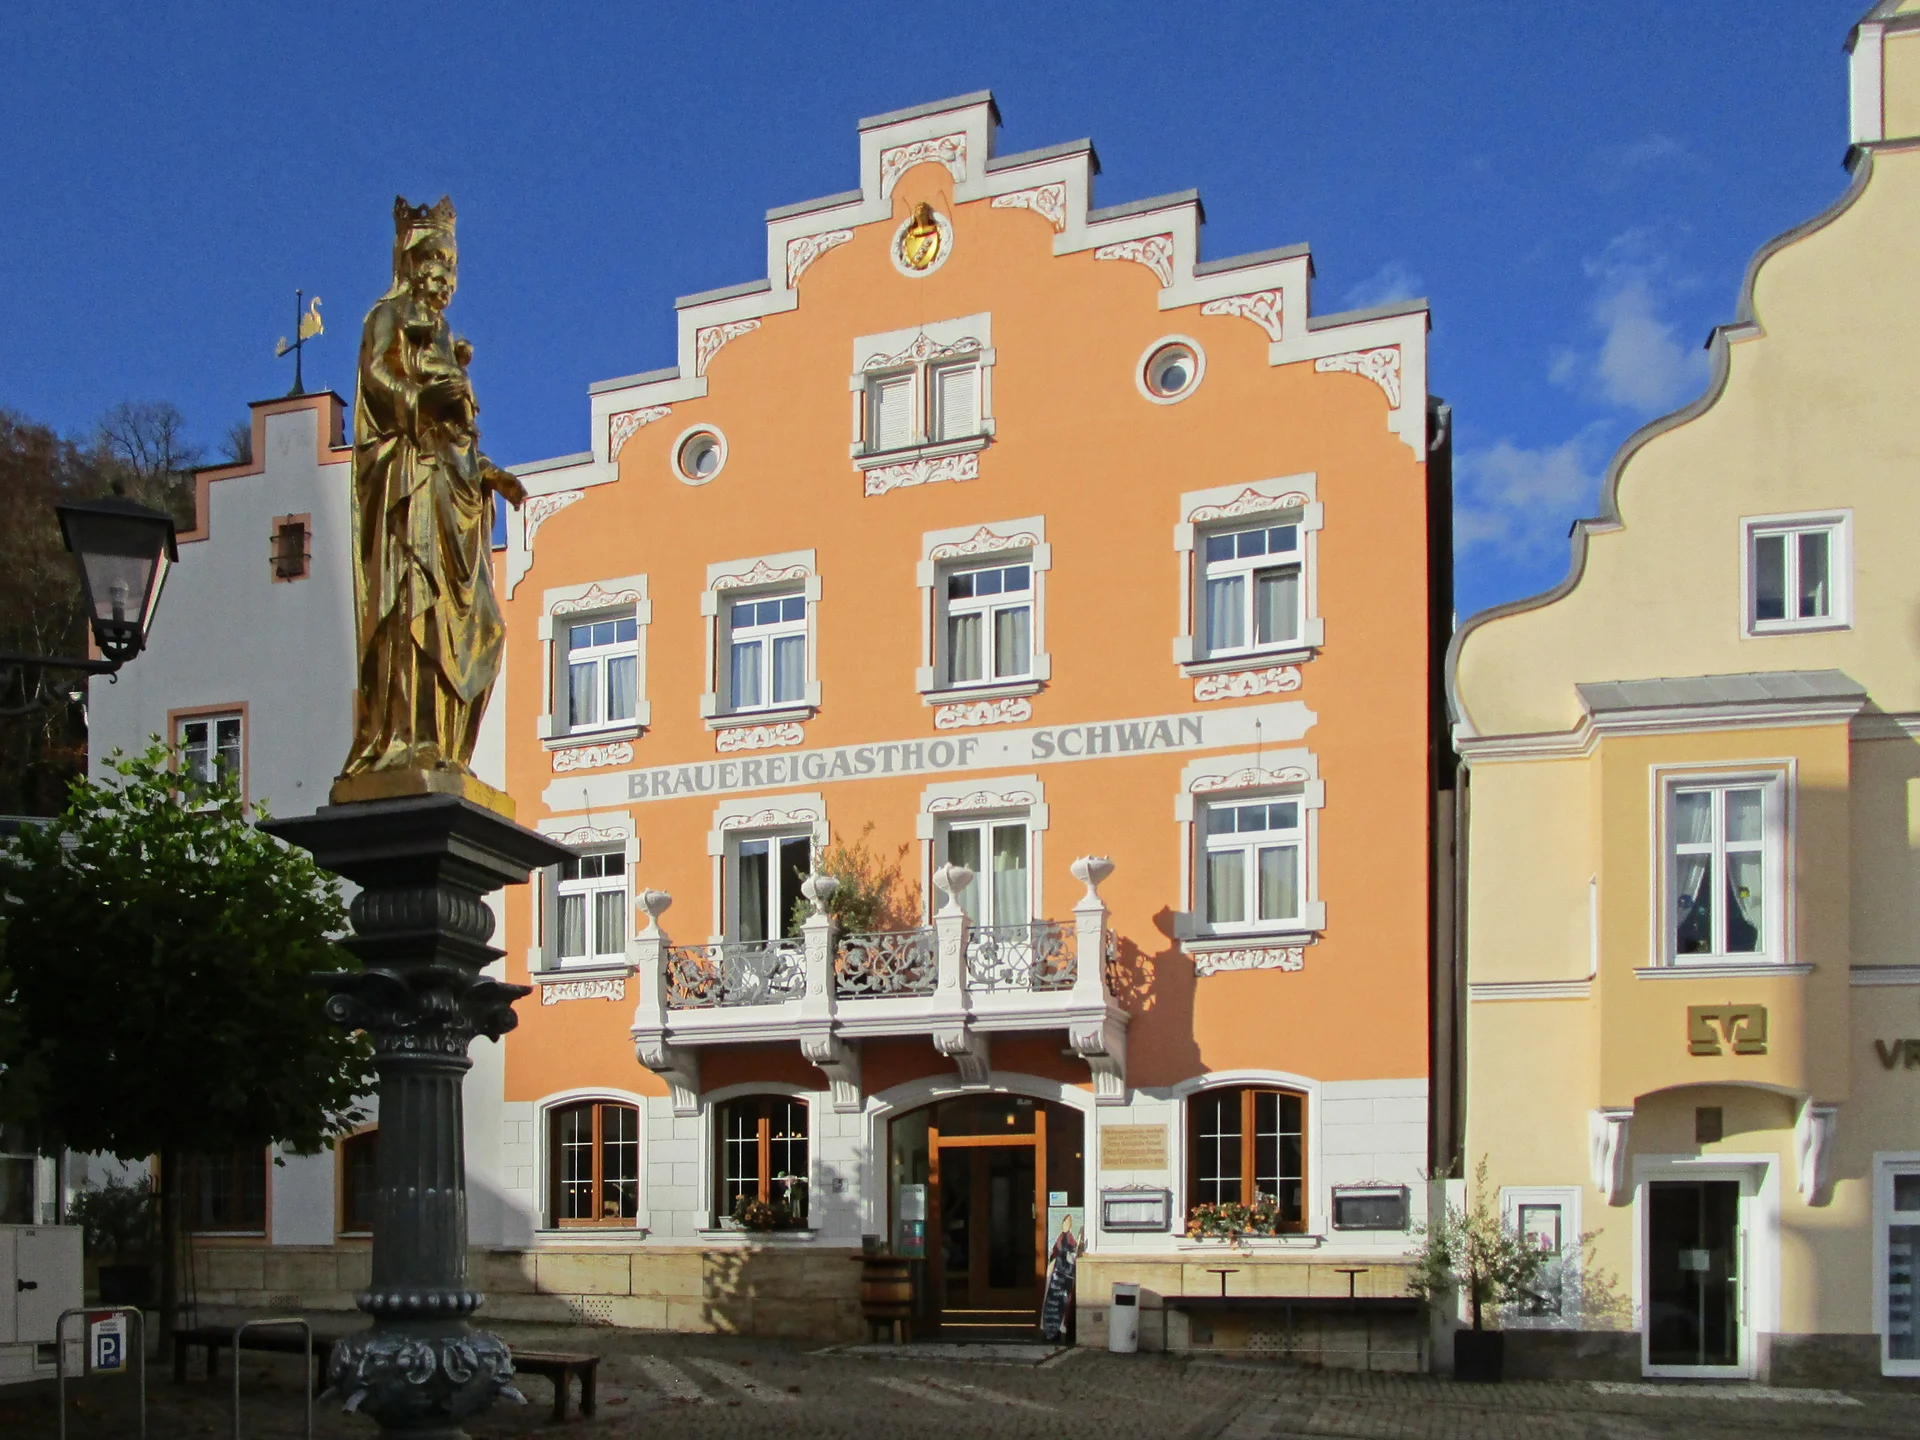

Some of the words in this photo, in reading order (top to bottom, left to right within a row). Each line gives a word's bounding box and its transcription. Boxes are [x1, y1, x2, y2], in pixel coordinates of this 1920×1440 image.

[628, 737, 978, 799] BRAUEREIGASTHOF
[1031, 715, 1204, 760] SCHWAN
[100, 1338, 115, 1365] P
